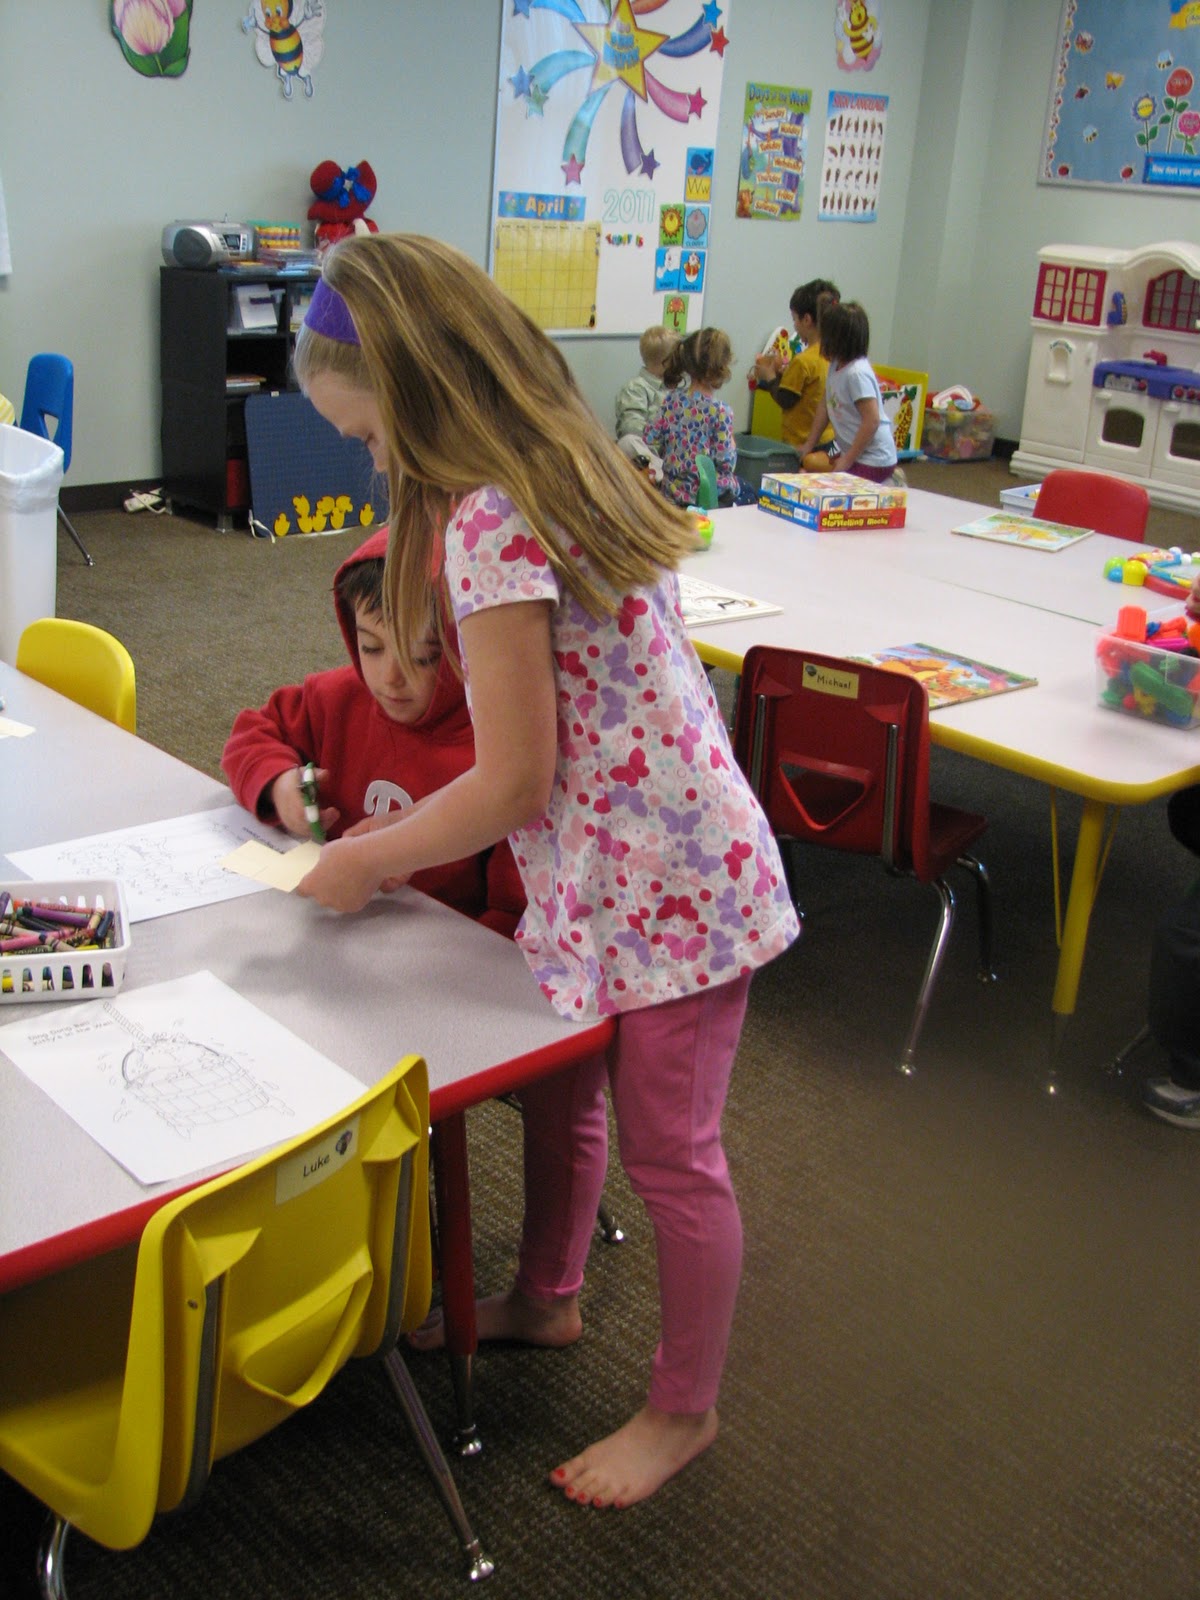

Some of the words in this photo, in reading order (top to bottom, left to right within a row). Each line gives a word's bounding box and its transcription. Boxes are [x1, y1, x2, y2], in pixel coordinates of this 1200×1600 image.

[749, 83, 770, 103] Days
[687, 176, 711, 195] Ww
[525, 194, 565, 217] April
[602, 188, 656, 223] 2011
[822, 517, 865, 527] Storytelling
[867, 517, 889, 526] Blocks
[817, 675, 851, 689] Michael
[304, 1154, 330, 1177] Luke
